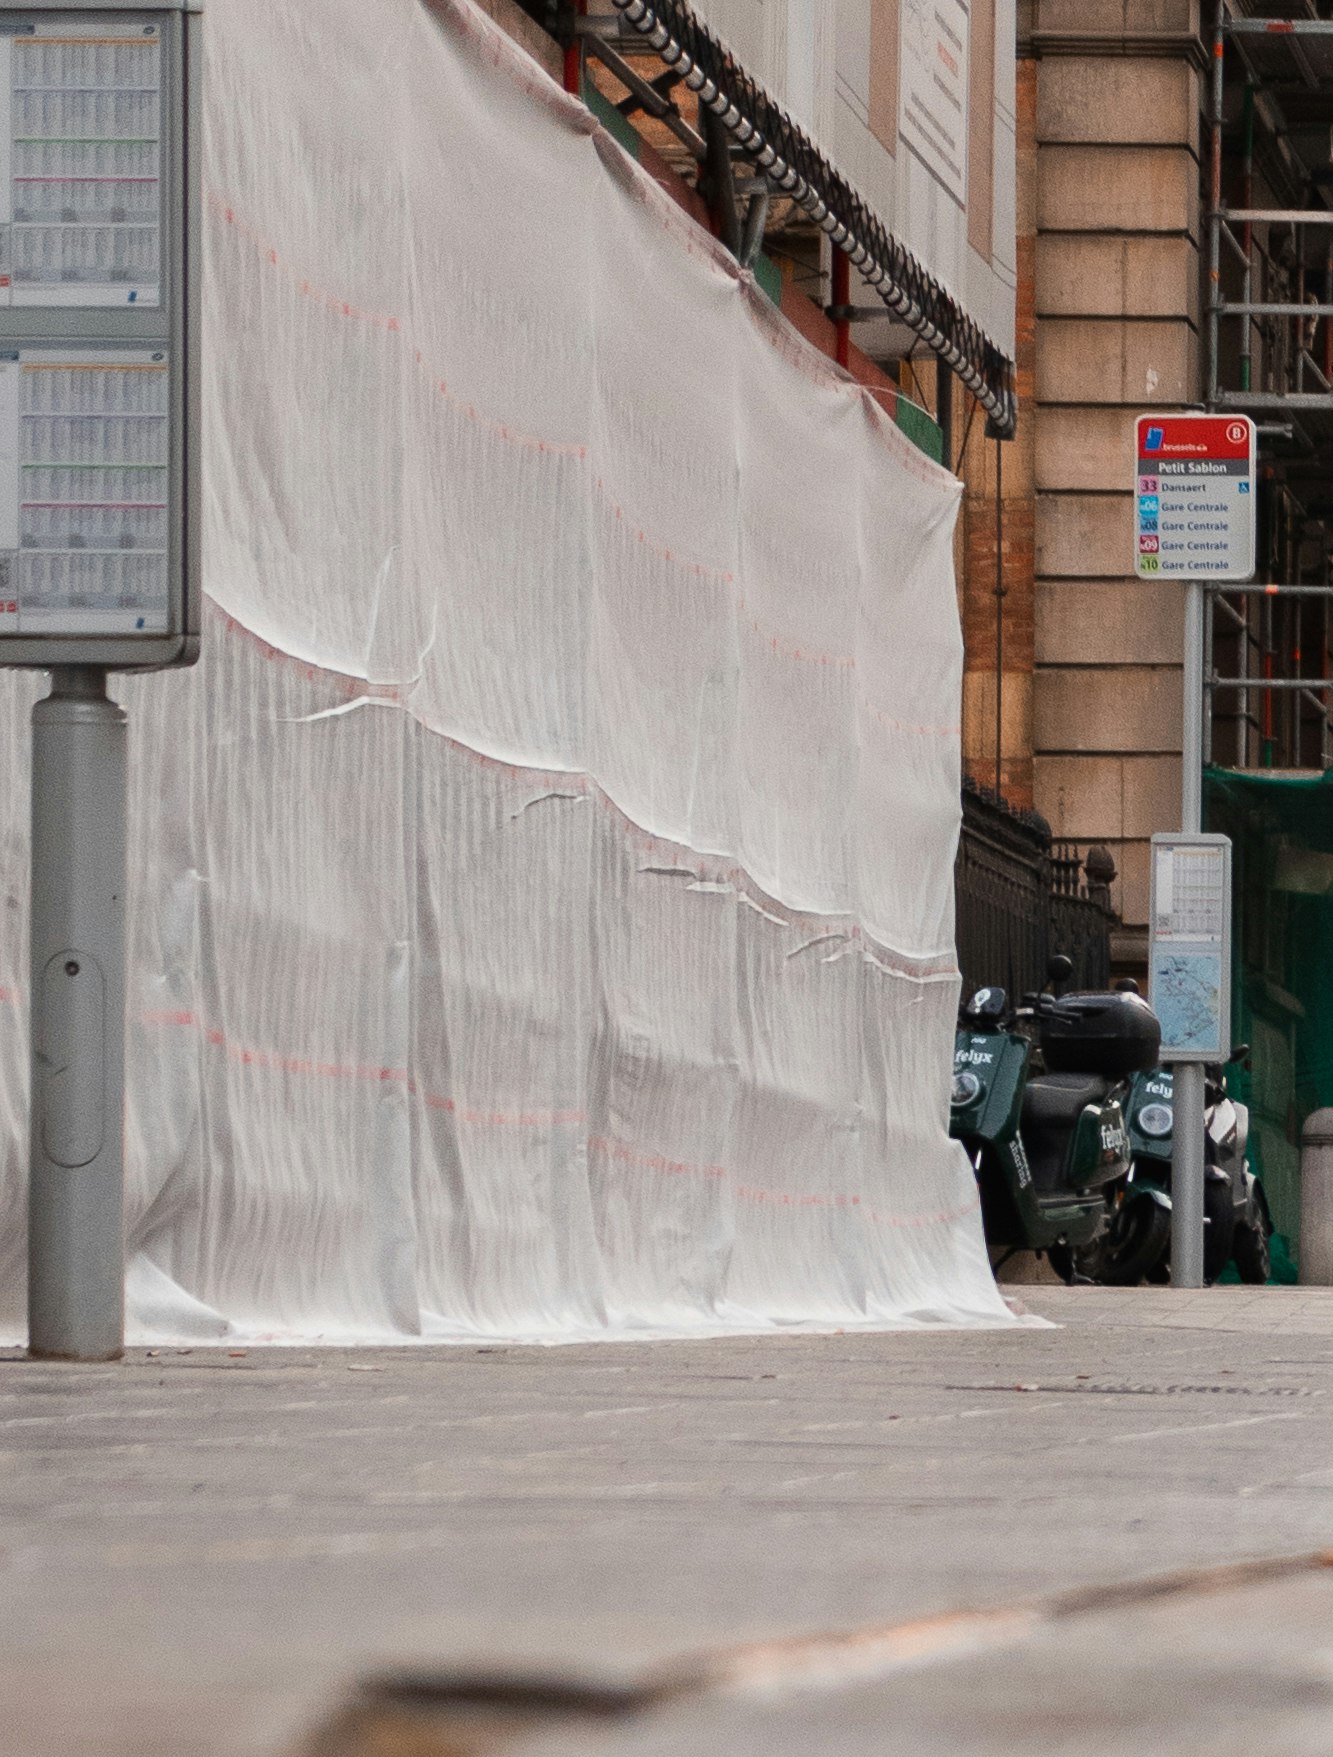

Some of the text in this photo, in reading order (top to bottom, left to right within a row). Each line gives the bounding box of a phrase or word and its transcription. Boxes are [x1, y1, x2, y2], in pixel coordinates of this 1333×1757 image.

[1158, 462, 1227, 473] Petit Sablon
[1141, 479, 1206, 492] 33 Dansaert
[1161, 502, 1185, 511] Gare
[1187, 502, 1229, 511] Centrale
[1161, 522, 1185, 531] Gare
[1187, 521, 1229, 531] Centrale
[1161, 541, 1185, 550] Gare
[1187, 541, 1229, 551] Centrale
[1161, 561, 1185, 570] Gare
[1187, 560, 1229, 570] Centrale
[954, 1049, 994, 1064] felyx
[1145, 1081, 1174, 1099] fely
